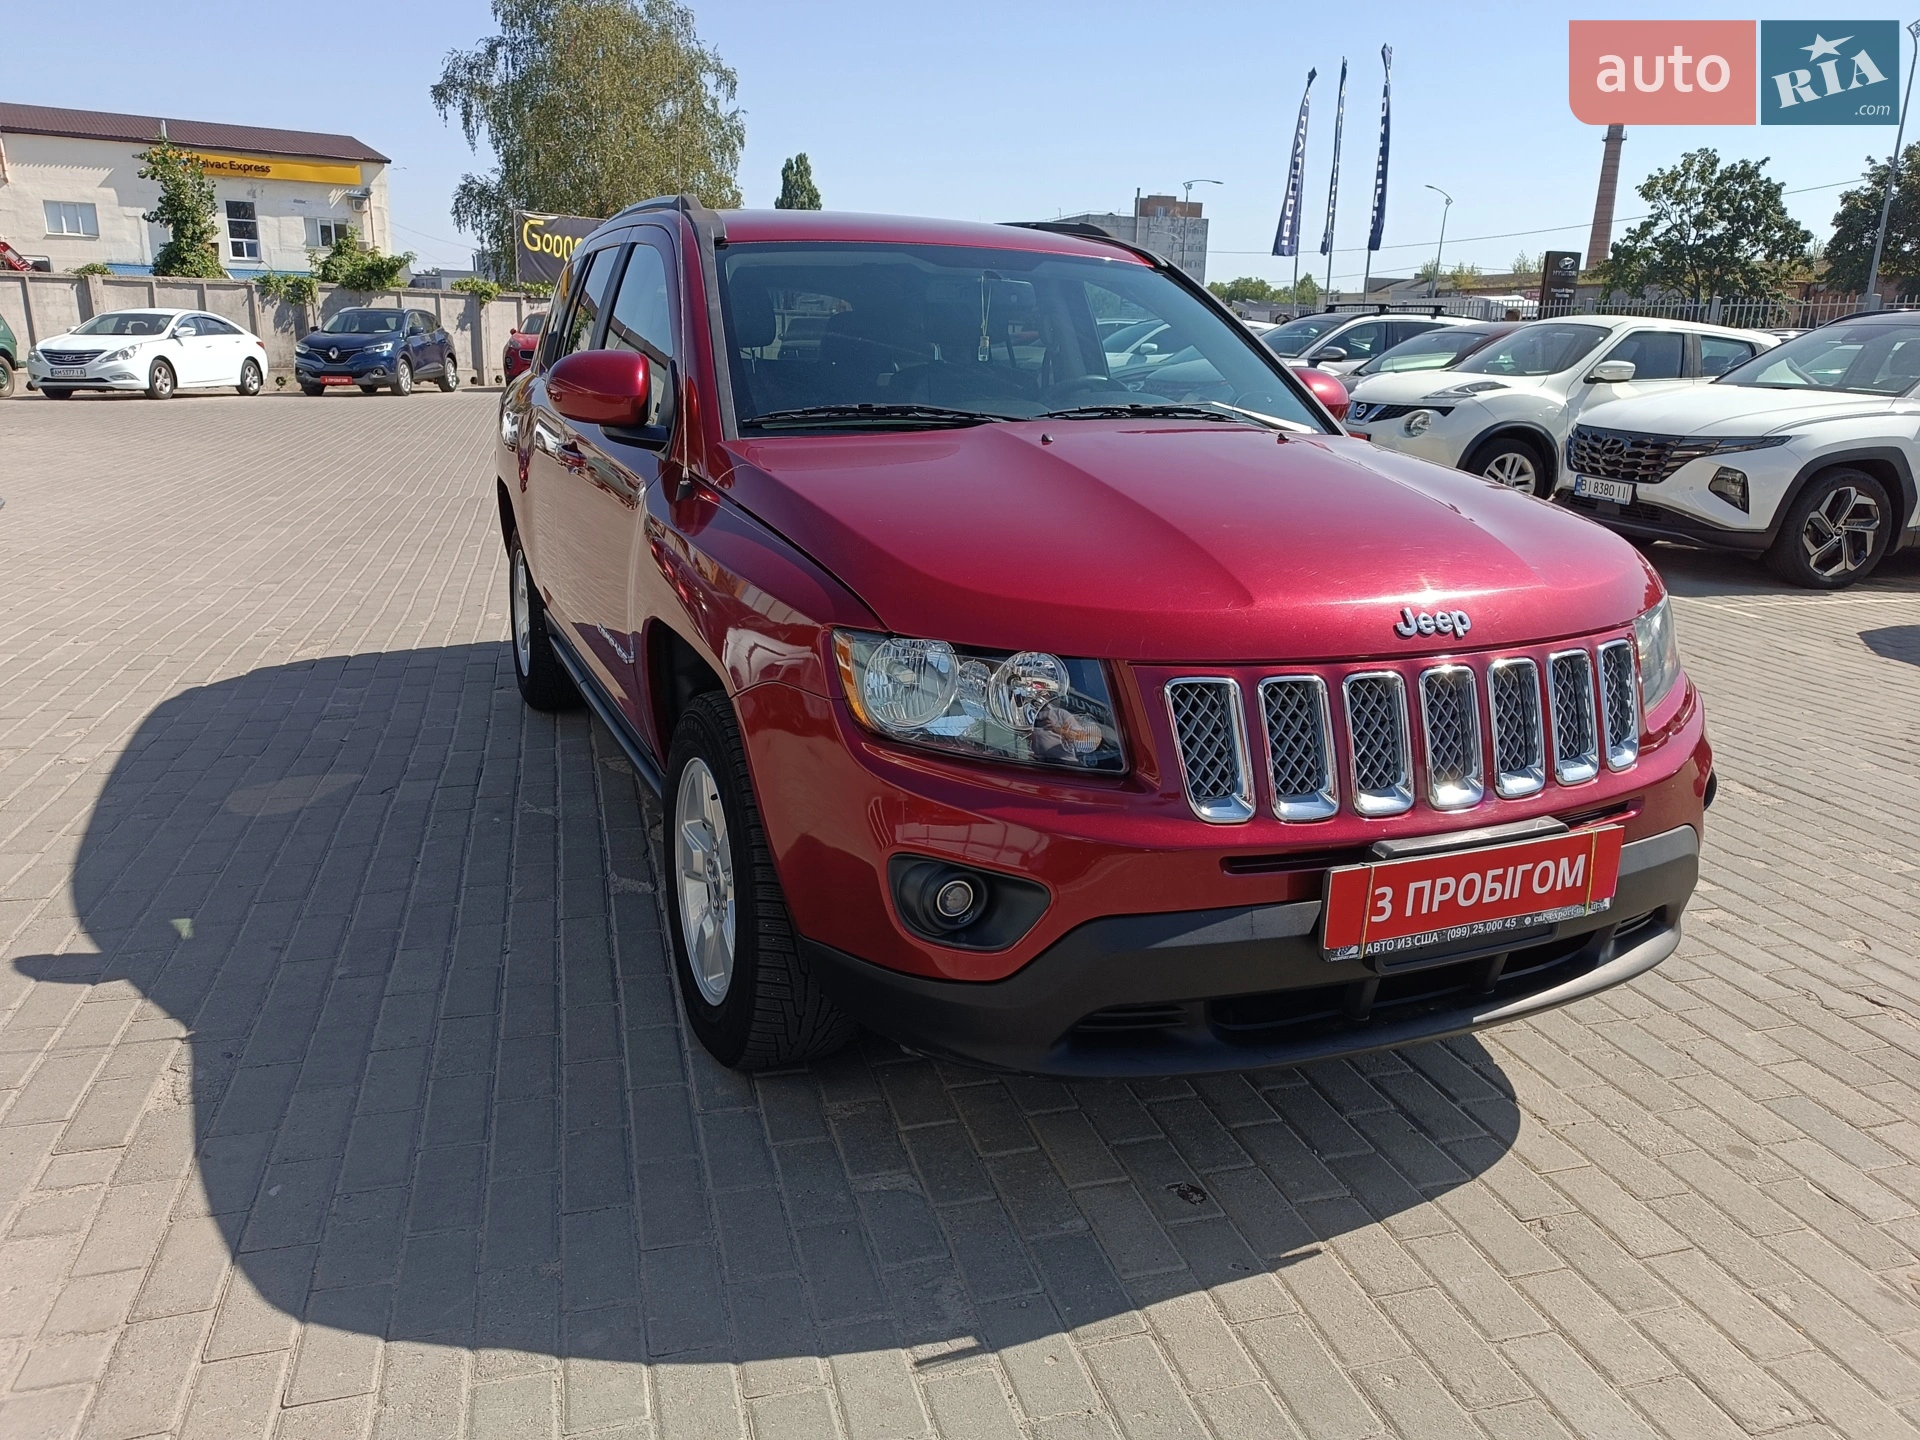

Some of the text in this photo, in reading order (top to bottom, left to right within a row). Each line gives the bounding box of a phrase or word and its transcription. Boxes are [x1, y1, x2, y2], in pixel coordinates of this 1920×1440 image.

[230, 160, 271, 174] Express
[1593, 481, 1615, 497] 8380
[1396, 607, 1472, 638] Jeep
[1371, 853, 1586, 923] З ПРОБІГОМ
[1365, 940, 1395, 955] АВТО
[1397, 937, 1412, 949] ИЗ
[1414, 932, 1439, 946] США
[1447, 926, 1470, 942] (099)
[1505, 918, 1517, 928] 45
